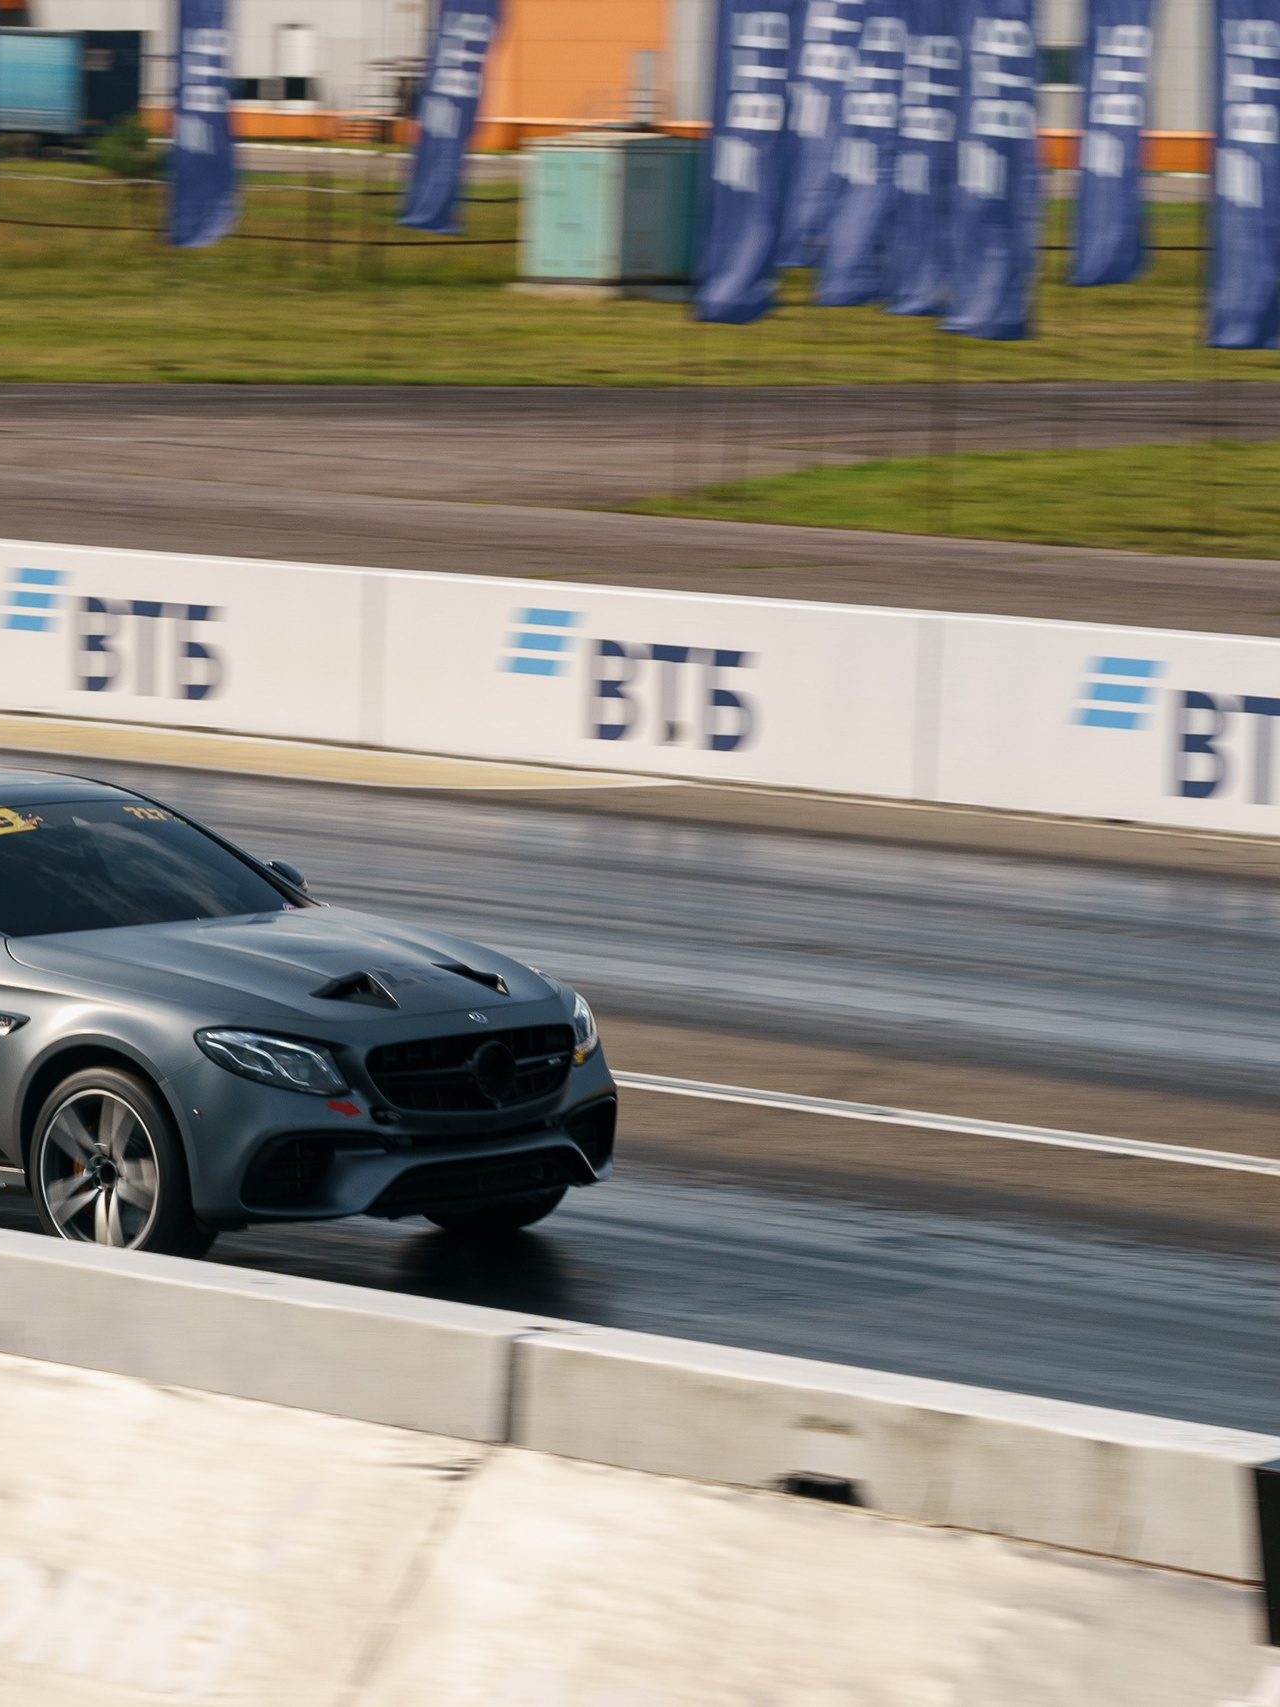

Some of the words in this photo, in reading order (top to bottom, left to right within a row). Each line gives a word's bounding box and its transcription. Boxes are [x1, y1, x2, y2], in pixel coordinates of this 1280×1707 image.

[76, 596, 229, 700] ВТБ
[588, 638, 756, 752] ВТБ
[122, 806, 167, 821] 717
